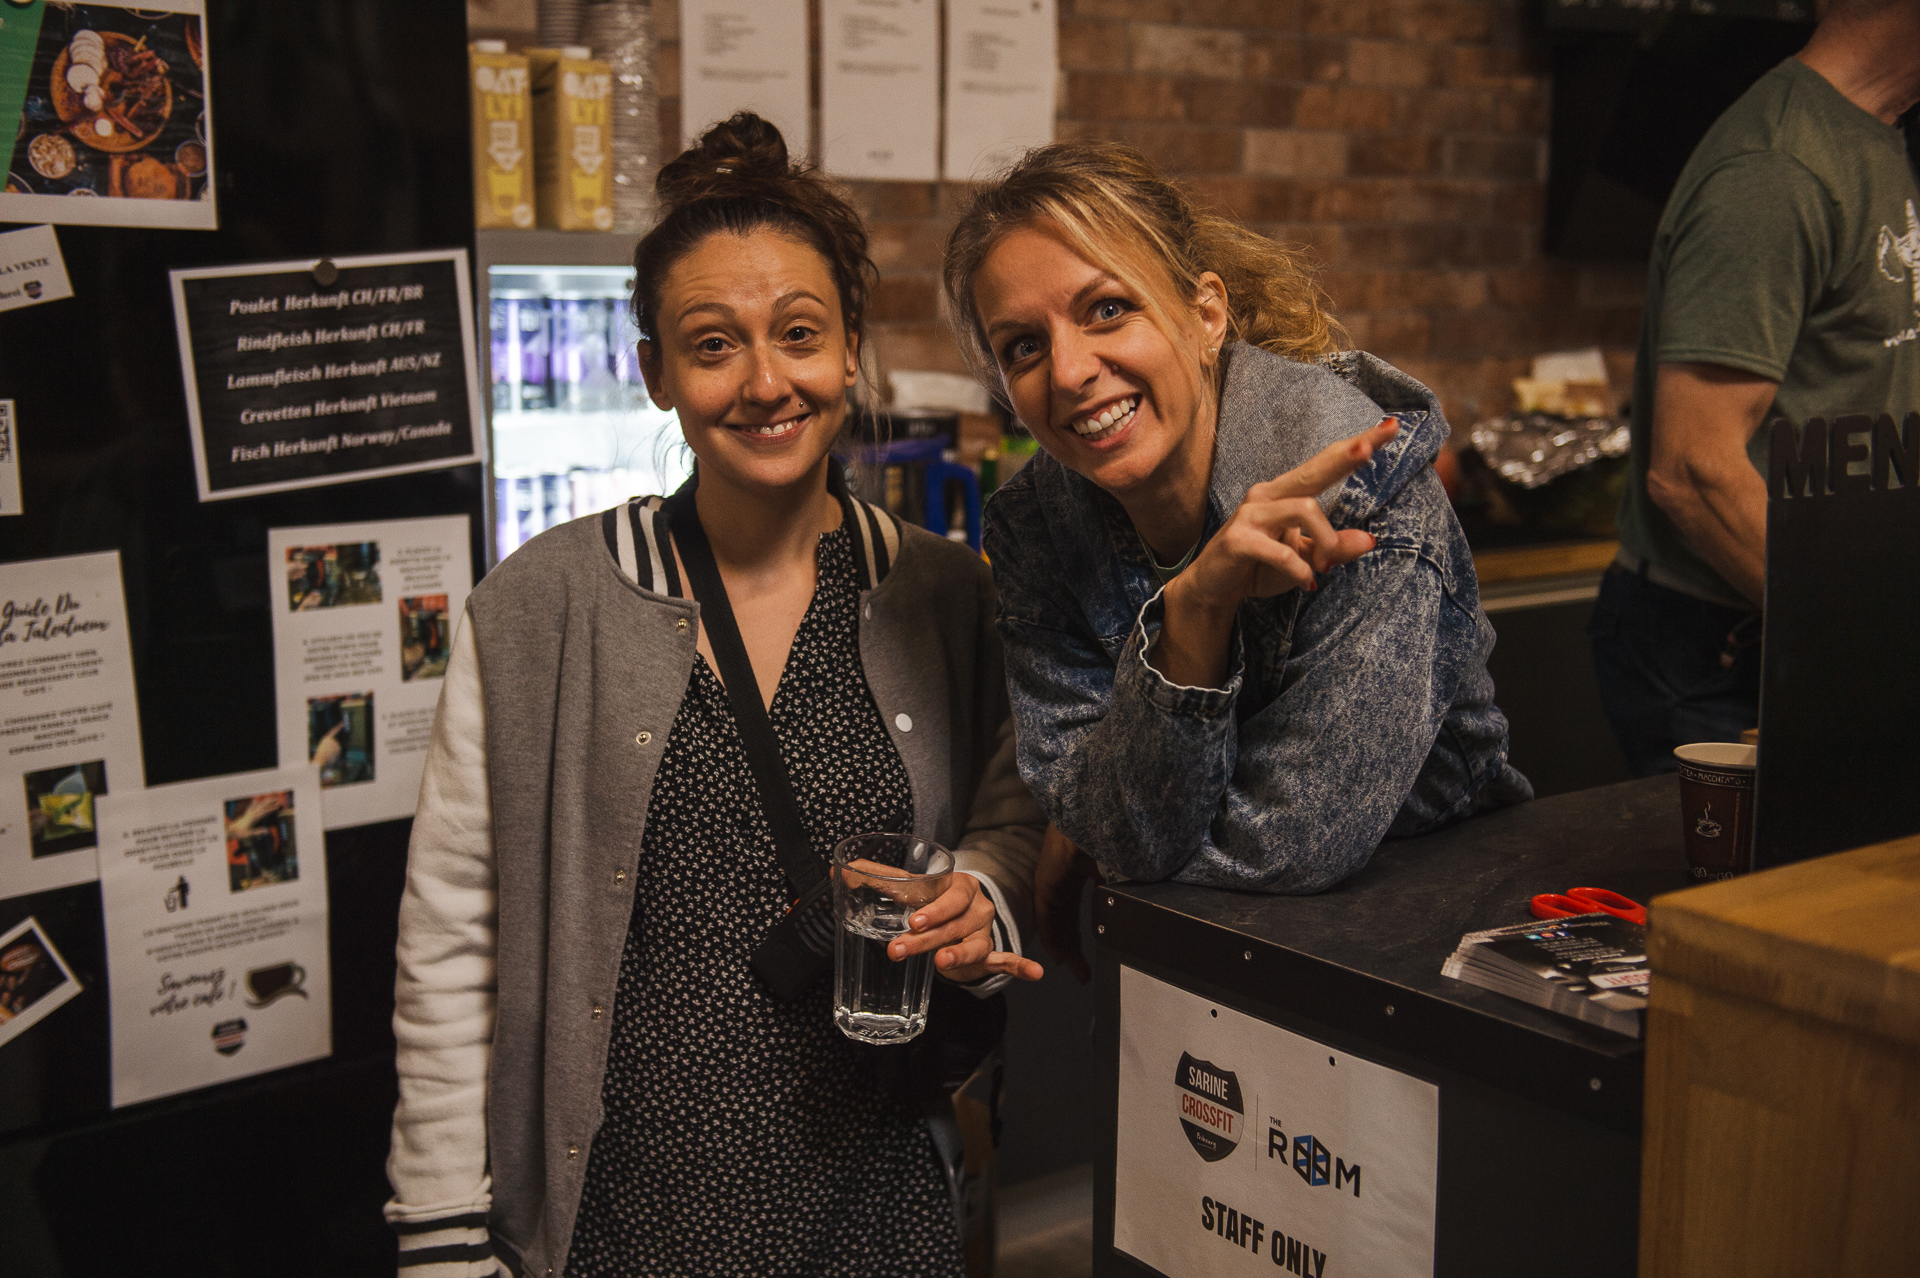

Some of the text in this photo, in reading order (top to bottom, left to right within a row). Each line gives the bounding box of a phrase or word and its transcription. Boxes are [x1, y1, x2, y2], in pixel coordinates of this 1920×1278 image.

[229, 284, 424, 315] Poulet Herkunft CH/FR/BR
[237, 319, 425, 352] Rindfleish Herkunft CH/FR
[227, 352, 441, 390] Lammfleisch Herkunft AUS/NZ
[240, 390, 437, 425] Crevetten Herkunft Vietnam
[231, 420, 452, 463] Fisch Herkunft Norway/Canada
[1189, 1066, 1229, 1101] SARINE
[1182, 1093, 1234, 1134] CROSSFIT
[1269, 1116, 1282, 1128] THE
[1201, 1195, 1327, 1278] STAFF ONLY
